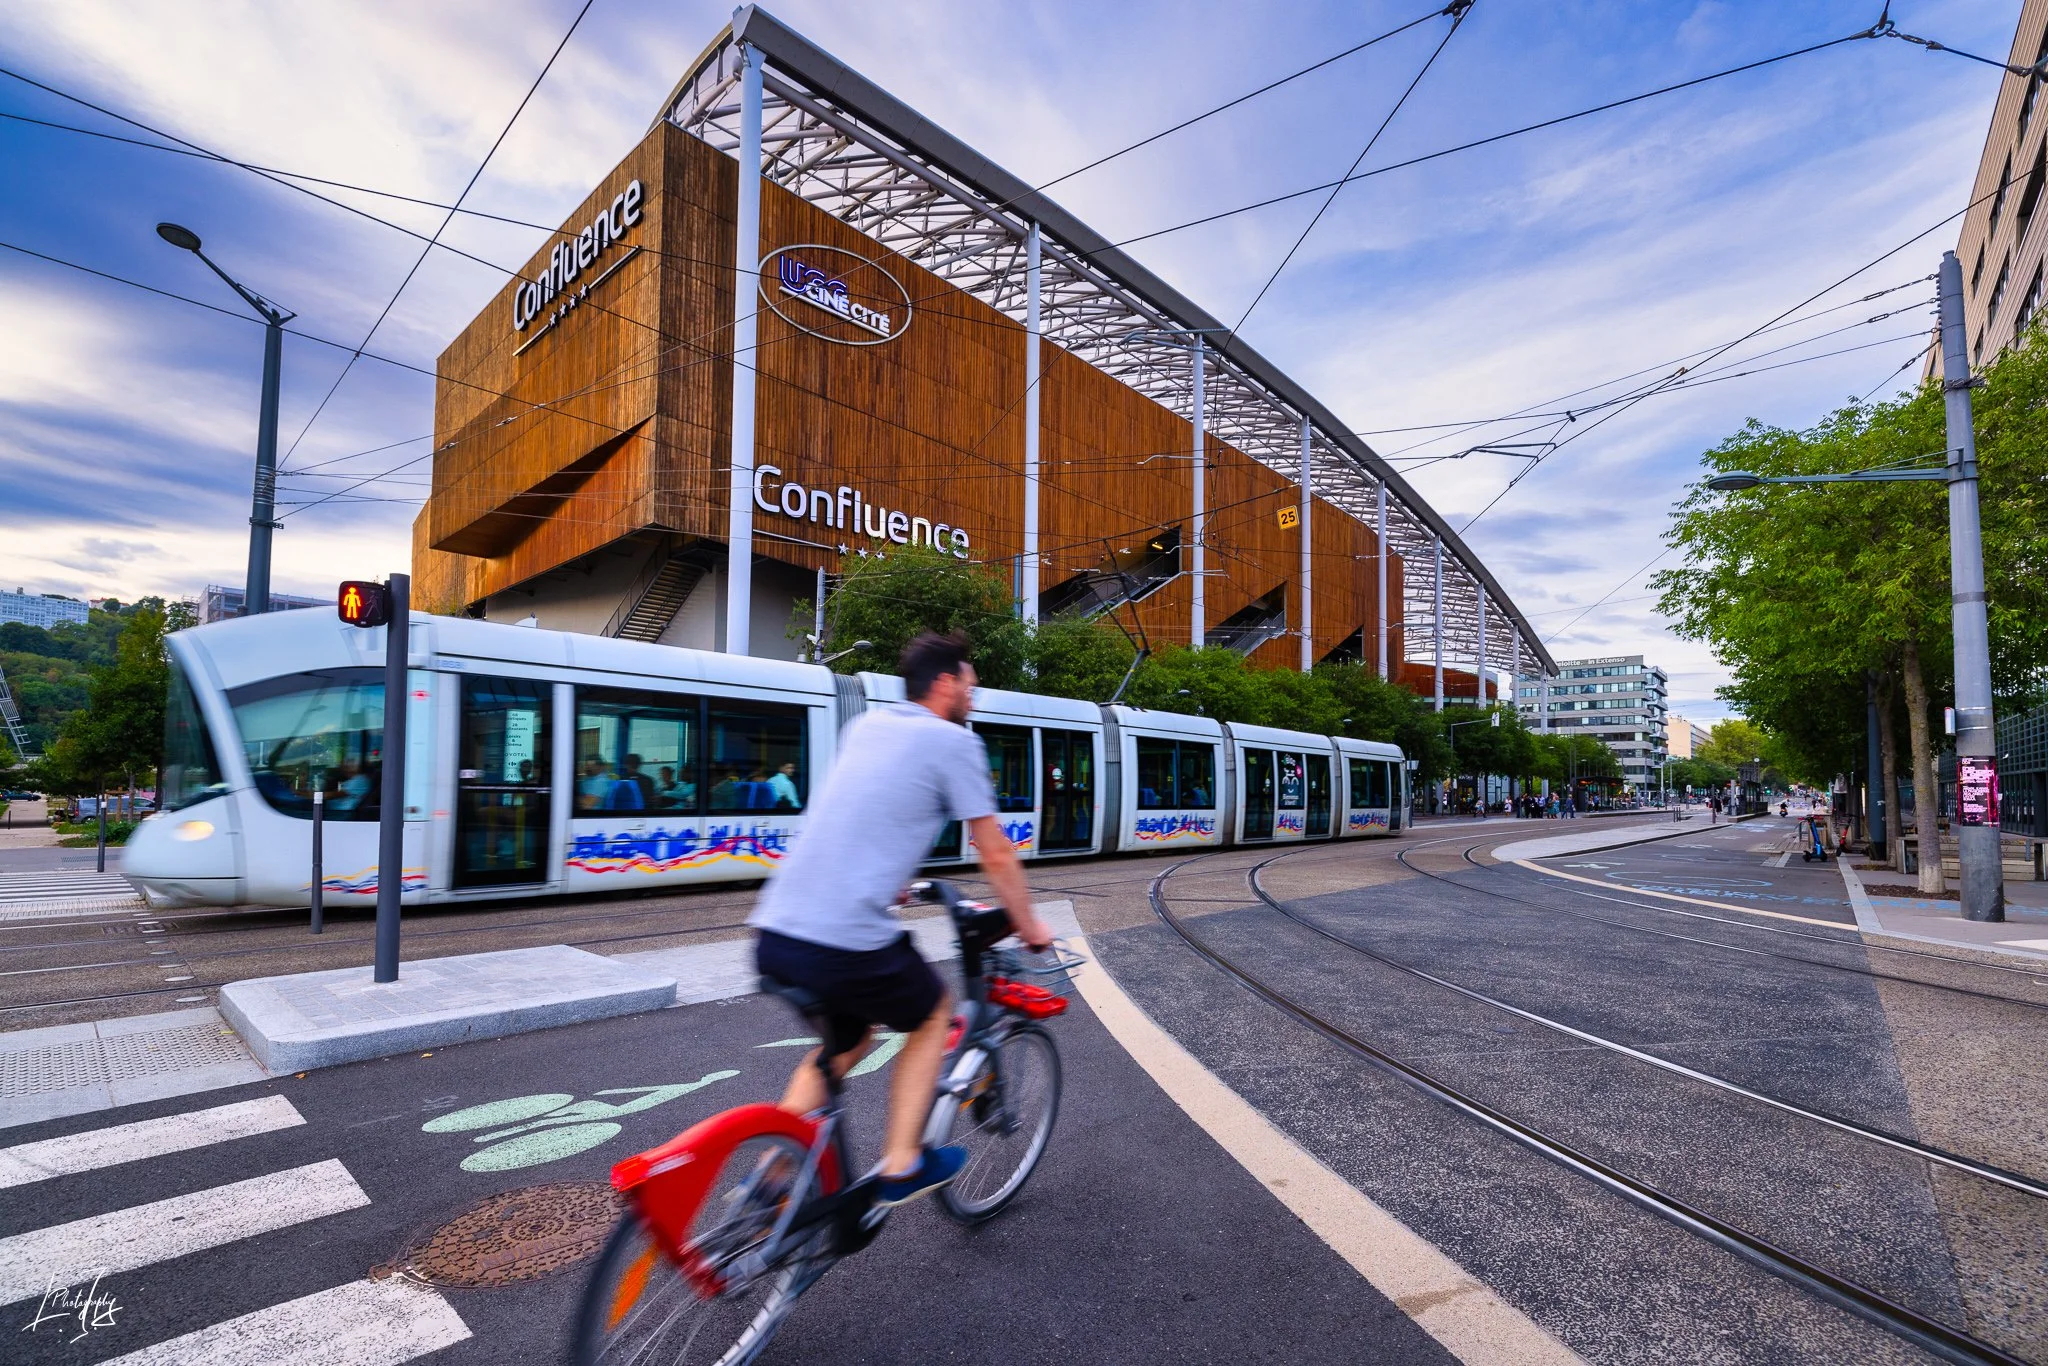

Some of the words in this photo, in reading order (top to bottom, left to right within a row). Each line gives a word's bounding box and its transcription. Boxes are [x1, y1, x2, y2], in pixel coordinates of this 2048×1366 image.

[514, 179, 642, 331] Confluence
[753, 464, 969, 559] Confluence
[1281, 511, 1296, 525] 25
